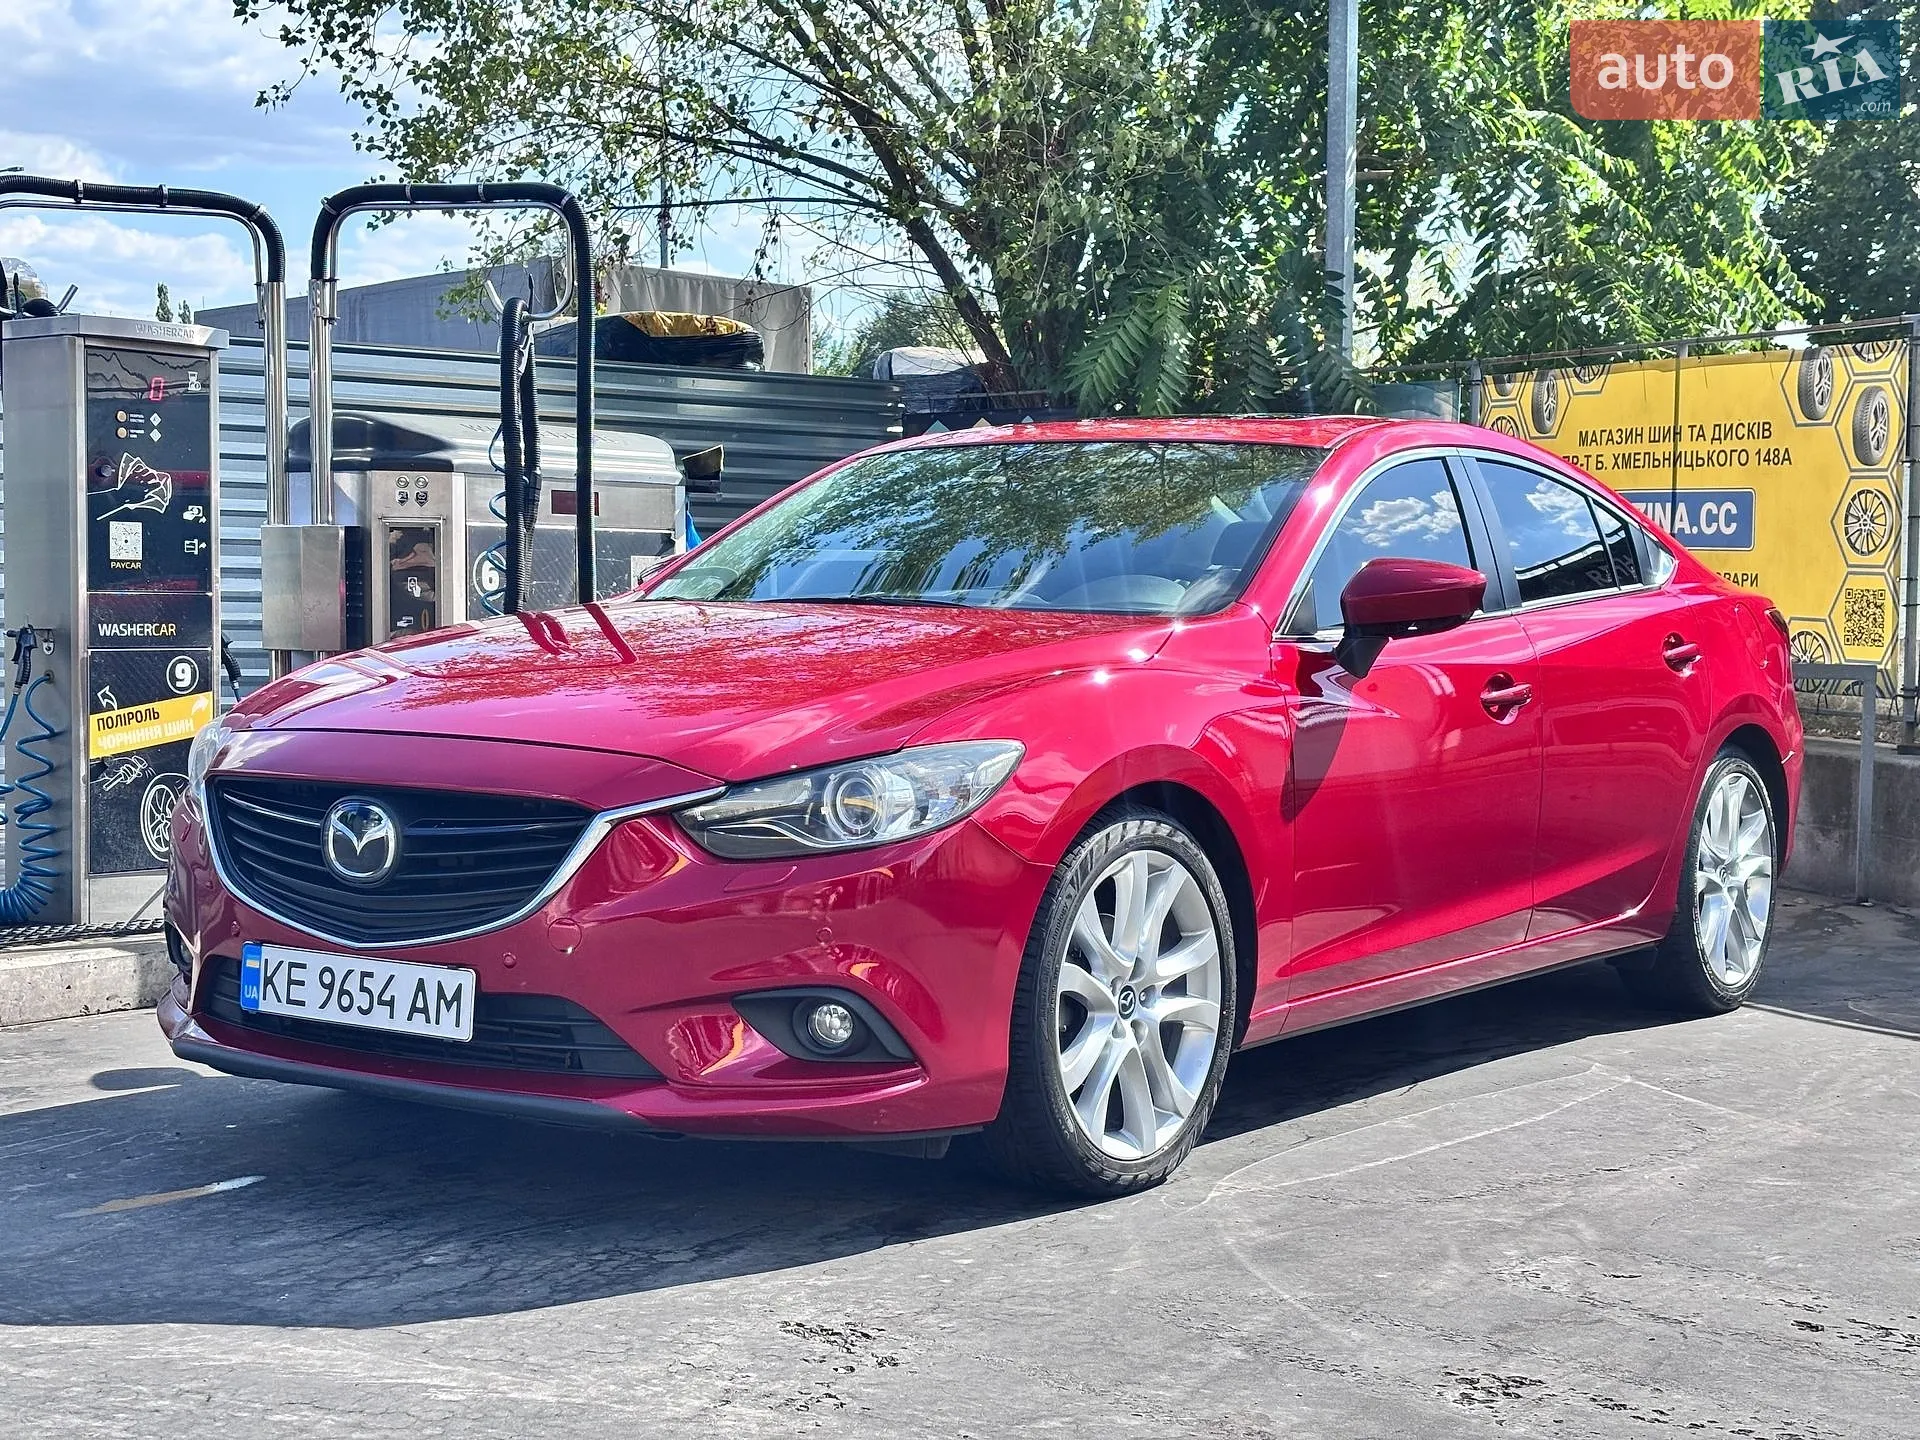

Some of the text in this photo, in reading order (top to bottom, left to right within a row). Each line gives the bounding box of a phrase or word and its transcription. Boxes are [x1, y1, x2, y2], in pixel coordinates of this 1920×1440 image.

[135, 323, 195, 339] WASHERCAR
[1578, 421, 1772, 447] МАГАЗИН ШИН ТА ДИСКІВ
[1595, 454, 1608, 471] Б.
[1611, 449, 1749, 471] ХМЕЛЬНИЦЬКОГО
[1755, 447, 1793, 467] 148А
[110, 560, 142, 571] PAYCAR
[481, 560, 500, 592] 6
[1716, 571, 1759, 588] ВАРИ
[98, 623, 177, 637] WASHERCAR
[174, 663, 192, 689] 9
[97, 707, 160, 732] ПОЛІРОЛЬ
[97, 718, 195, 750] ЧОРНІННЯ ШИН
[244, 985, 259, 1000] UA
[262, 957, 463, 1029] KE 9654 AM
